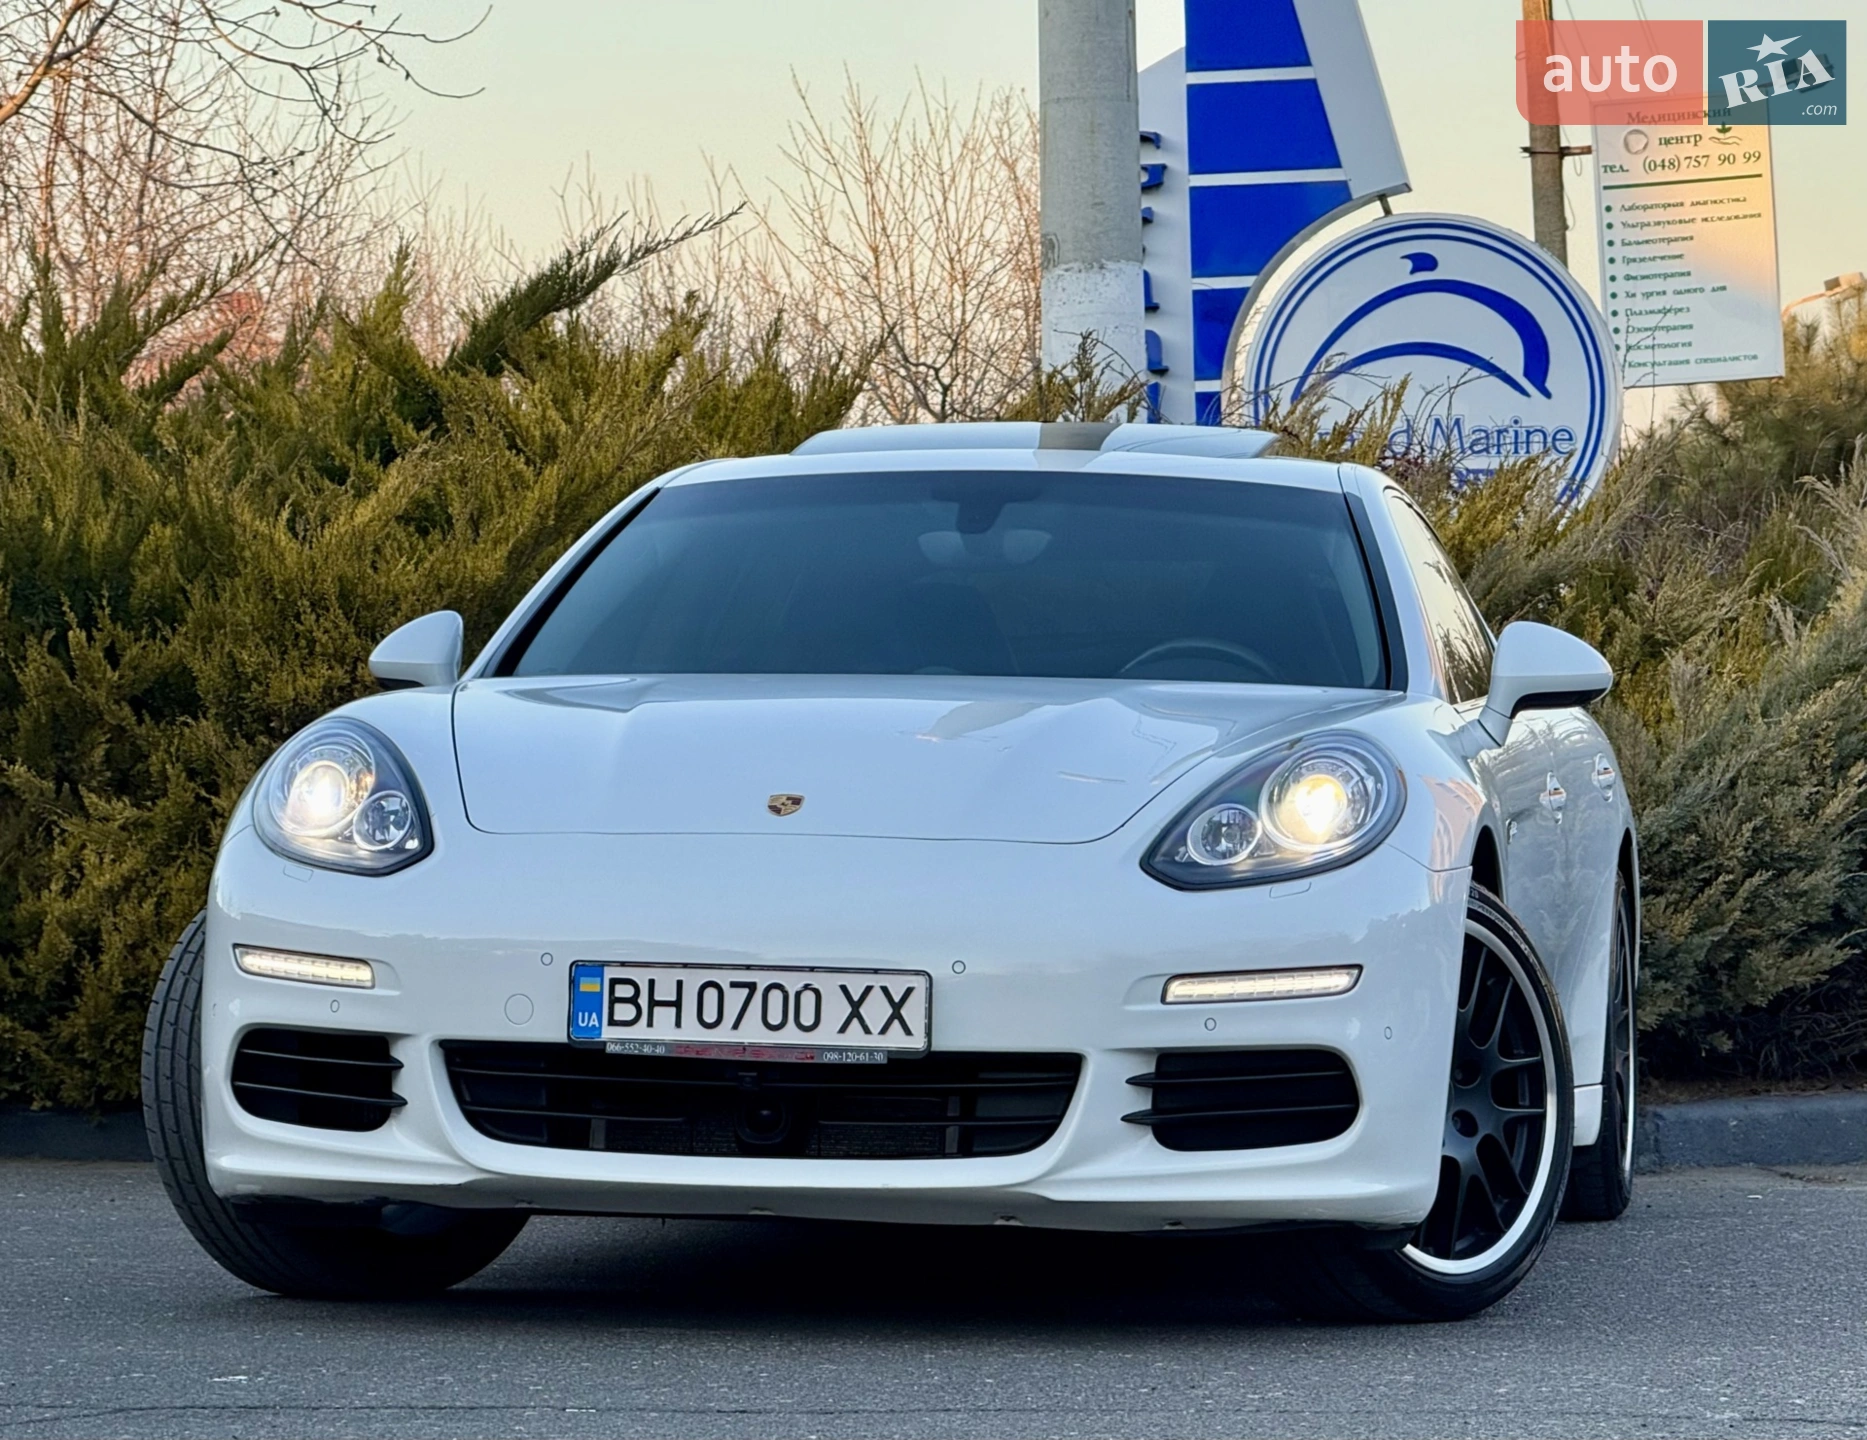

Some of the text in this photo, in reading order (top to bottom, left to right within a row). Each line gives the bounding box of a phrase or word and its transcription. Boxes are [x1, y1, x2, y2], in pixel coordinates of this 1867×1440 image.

[1626, 108, 1732, 125] Медицинский
[1658, 132, 1703, 147] центр
[1602, 150, 1762, 174] тел. (048) 757 90 99
[1619, 201, 1685, 213] Лабораторная
[1621, 215, 1697, 230] Ультразвуковые
[1621, 234, 1694, 247] Бальнеотерапия
[1622, 252, 1685, 266] Грязелечение
[1623, 270, 1692, 281] Физиотерапия
[1672, 286, 1705, 296] одного
[1710, 285, 1727, 293] дня
[1430, 415, 1576, 455] Marine
[607, 977, 917, 1037] BH 0700 XX
[577, 1011, 600, 1028] UA
[822, 1050, 884, 1063] 098-120-61-30
